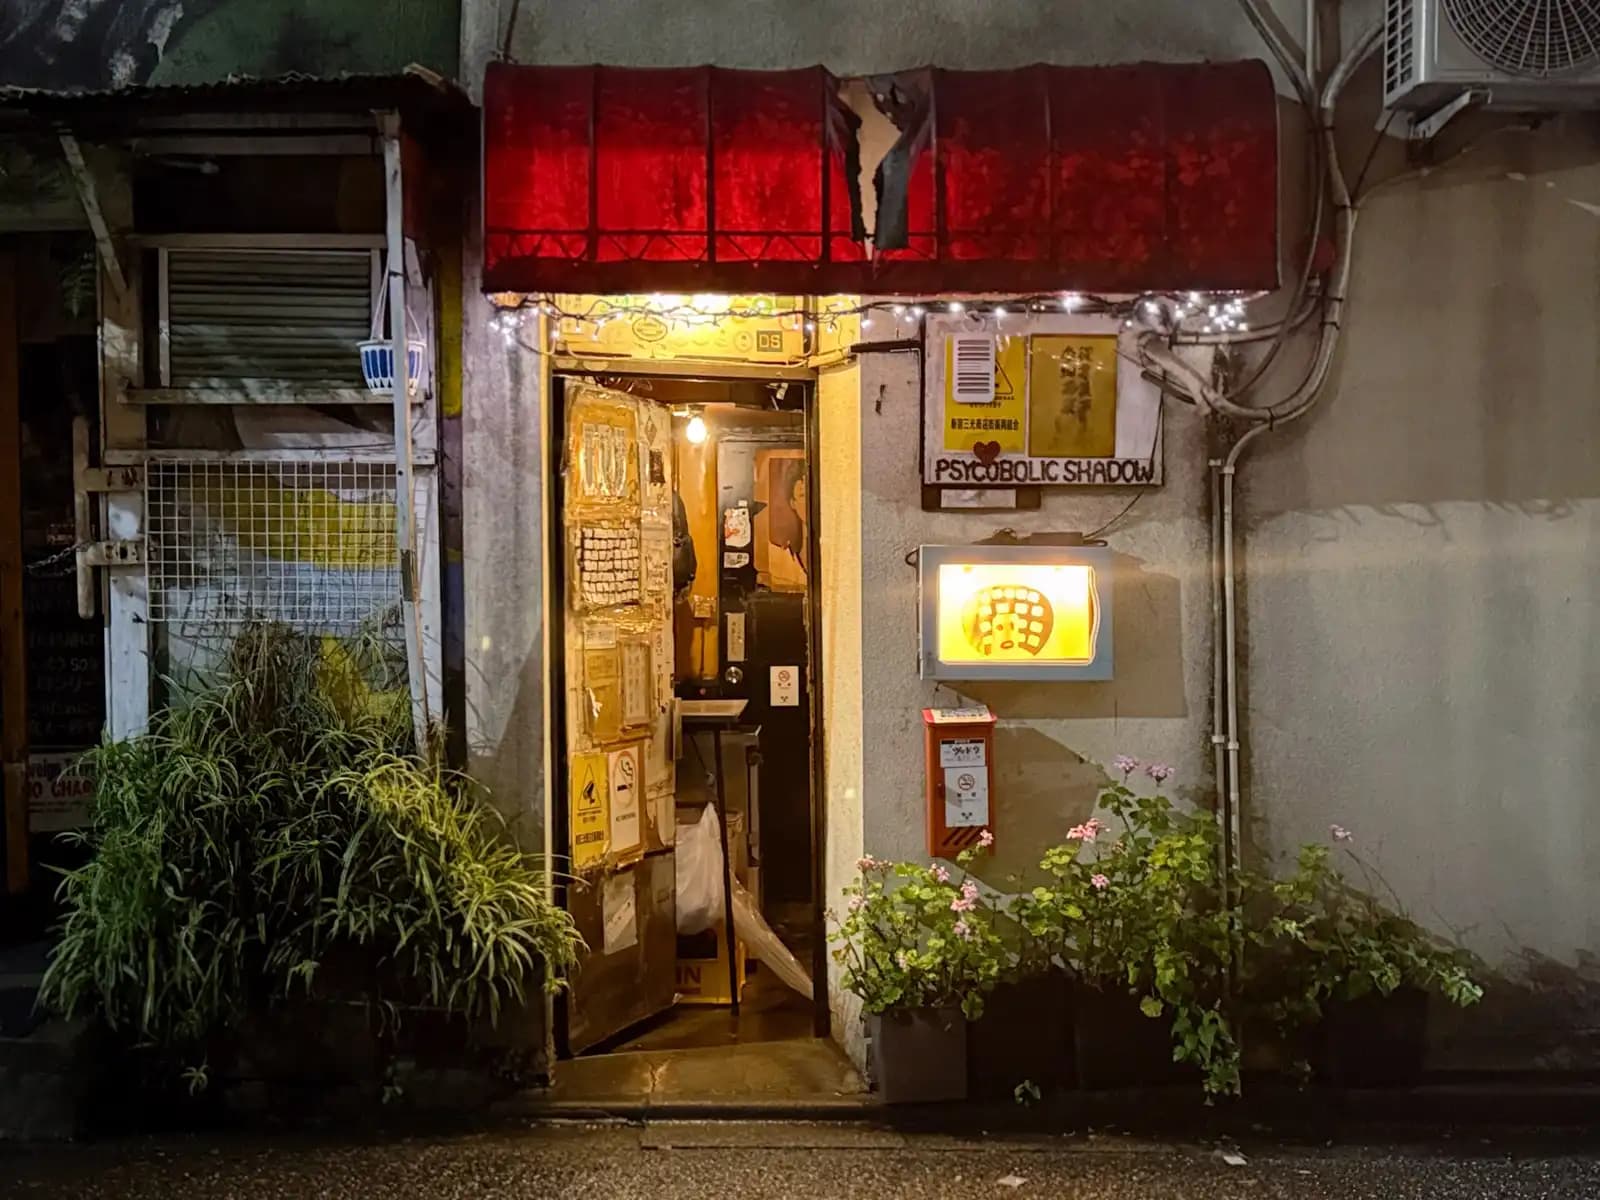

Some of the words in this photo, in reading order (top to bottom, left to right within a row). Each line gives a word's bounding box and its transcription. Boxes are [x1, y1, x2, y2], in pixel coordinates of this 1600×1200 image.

[760, 334, 782, 348] DS
[935, 458, 1058, 482] PSYCOBOLIC
[1063, 459, 1154, 483] SHADOW
